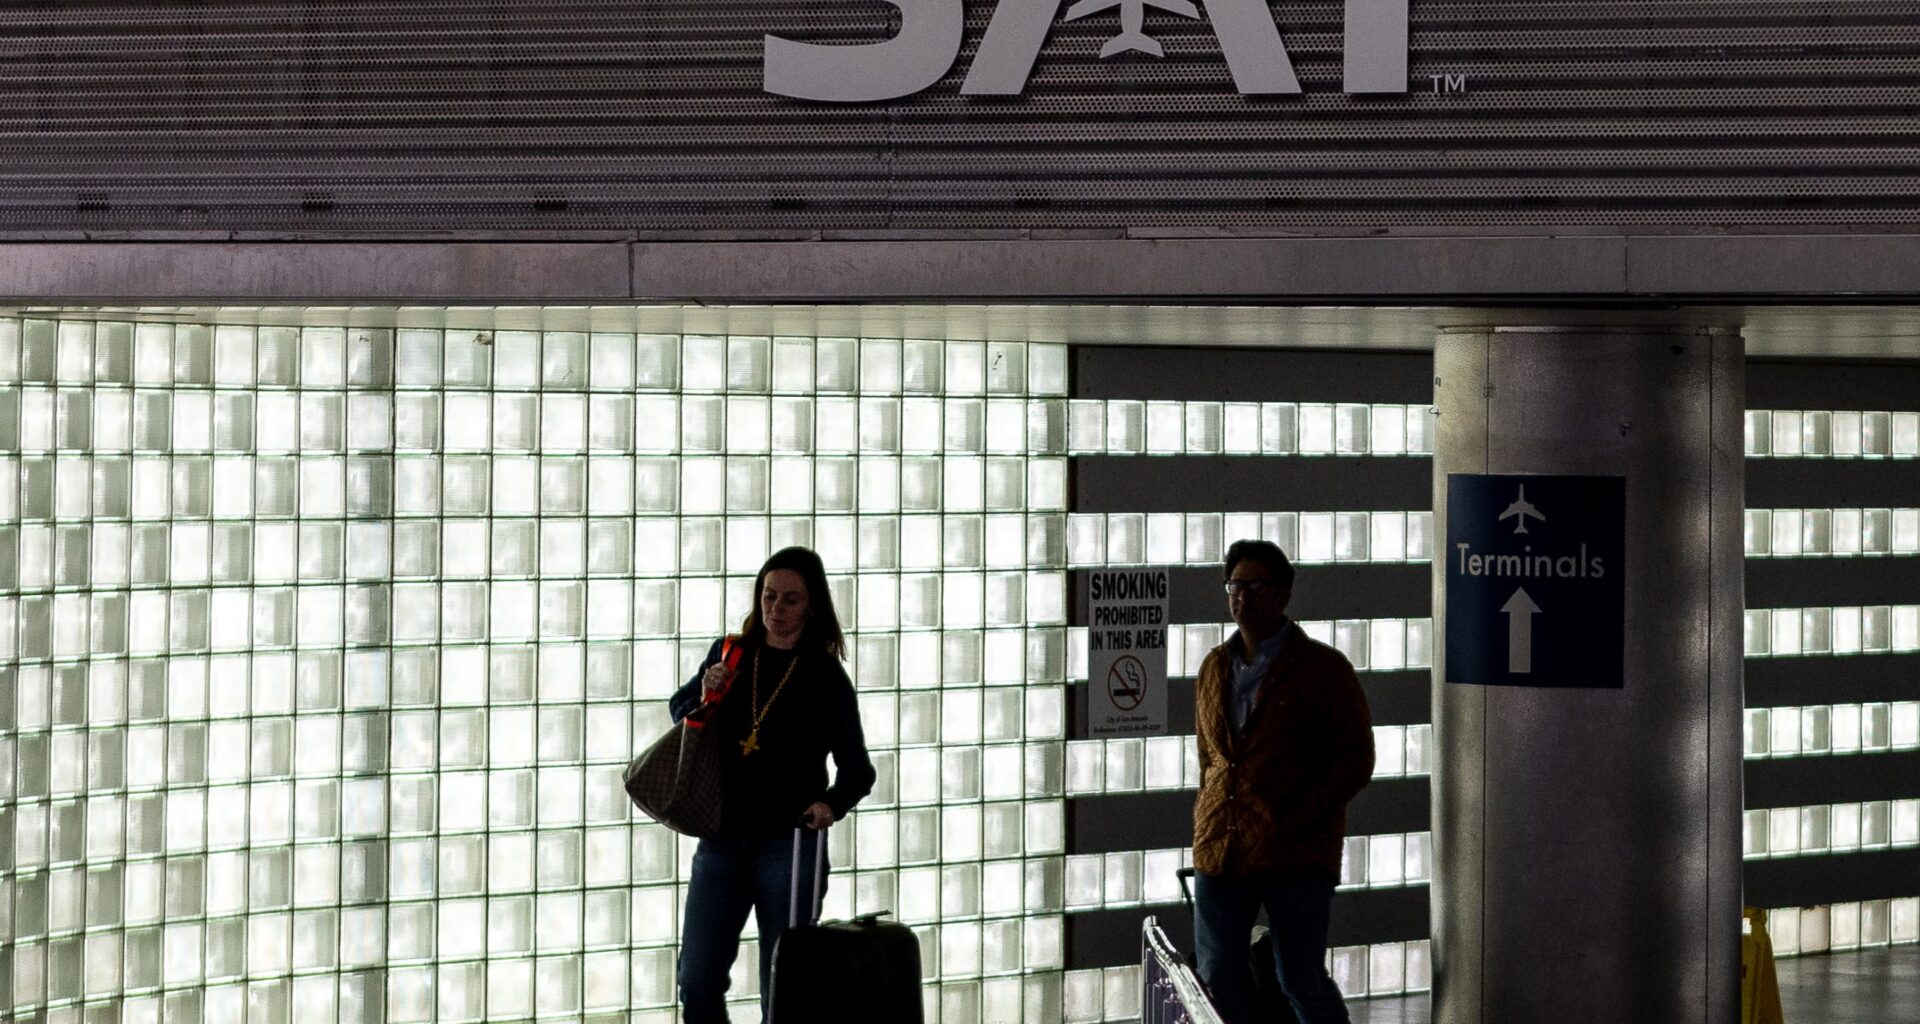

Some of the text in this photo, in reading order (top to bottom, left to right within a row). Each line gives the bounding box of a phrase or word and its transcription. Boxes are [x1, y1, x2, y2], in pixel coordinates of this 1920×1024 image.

[1429, 74, 1465, 93] TM
[1456, 542, 1606, 579] Terminals
[1091, 571, 1167, 601] SMOKING
[1094, 604, 1163, 626] PROHIBITED
[1091, 629, 1166, 650] IN THIS AREA
